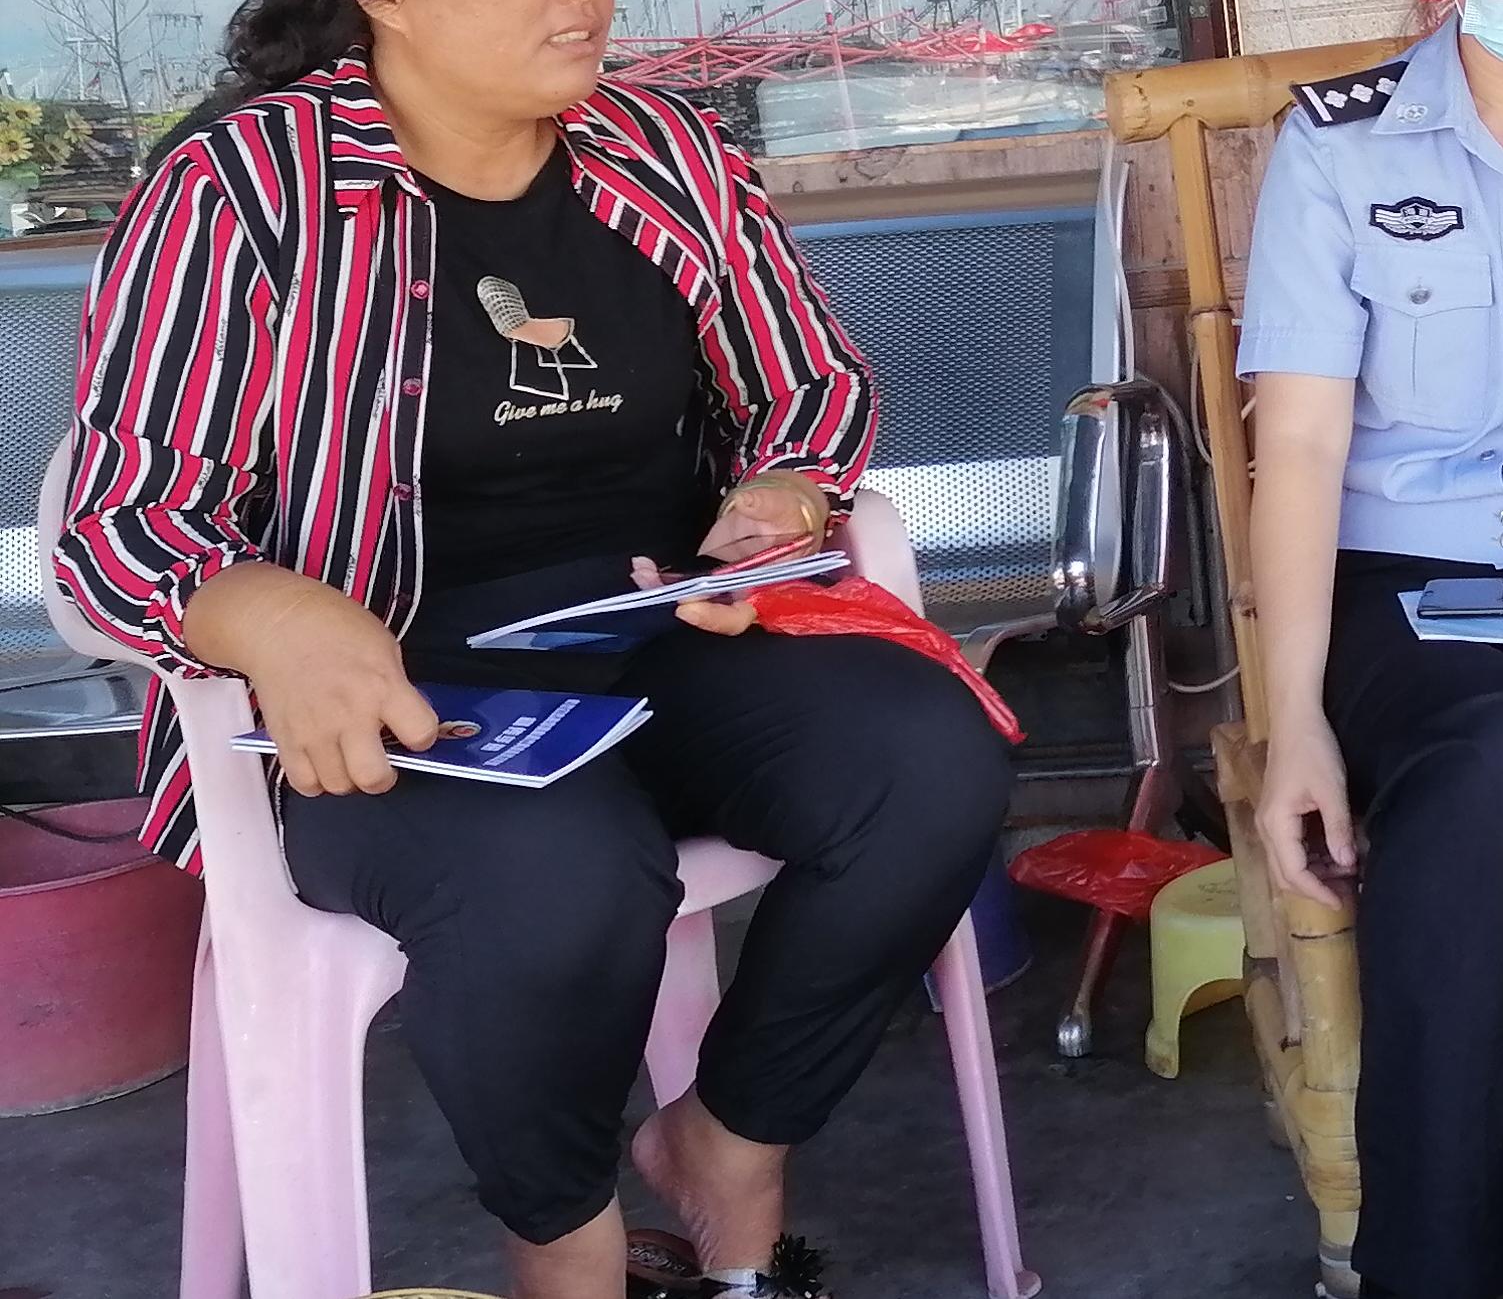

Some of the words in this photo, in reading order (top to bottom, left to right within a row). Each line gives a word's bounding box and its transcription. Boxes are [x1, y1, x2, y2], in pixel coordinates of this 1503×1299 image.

[494, 400, 537, 426] Give
[540, 402, 568, 416] me
[571, 400, 584, 413] a
[586, 389, 624, 413] hug
